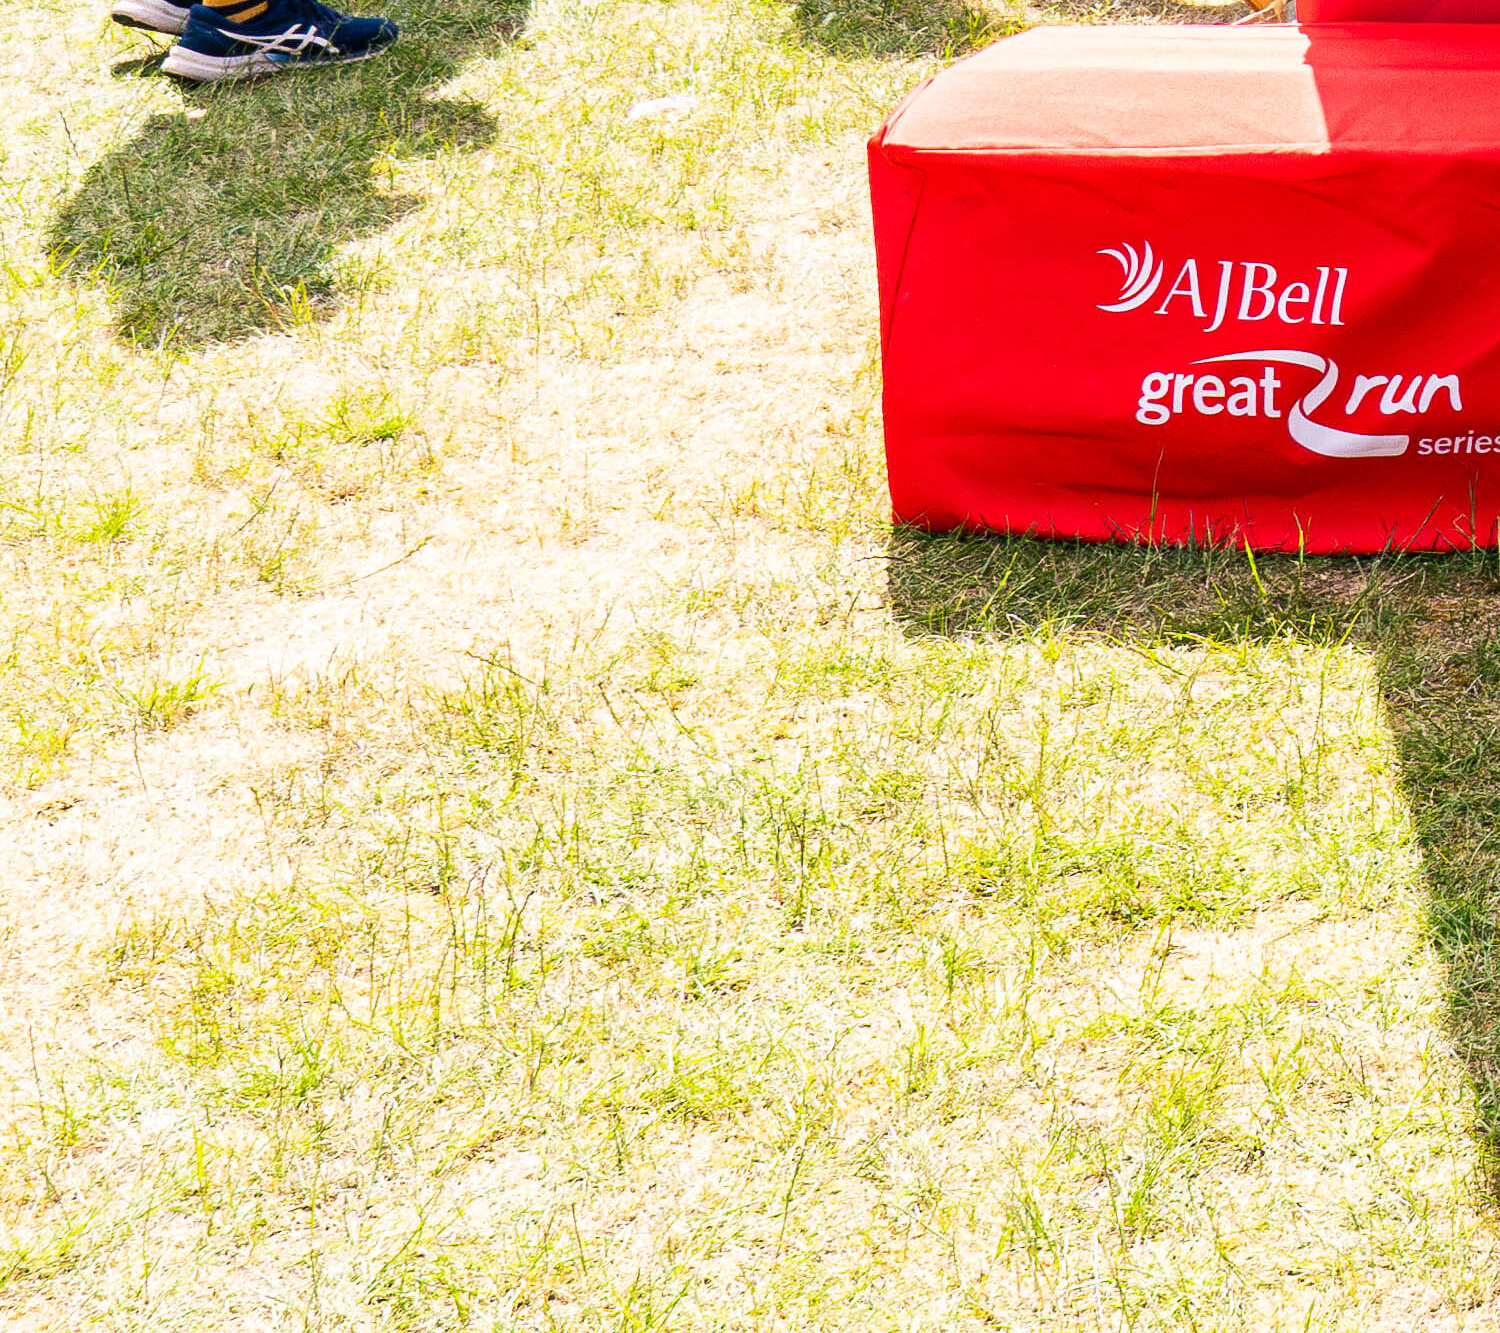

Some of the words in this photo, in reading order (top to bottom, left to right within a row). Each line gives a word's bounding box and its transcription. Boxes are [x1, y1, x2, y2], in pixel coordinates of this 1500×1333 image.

[1154, 256, 1349, 332] AJBell
[1135, 363, 1283, 426] great
[1346, 370, 1463, 416] run
